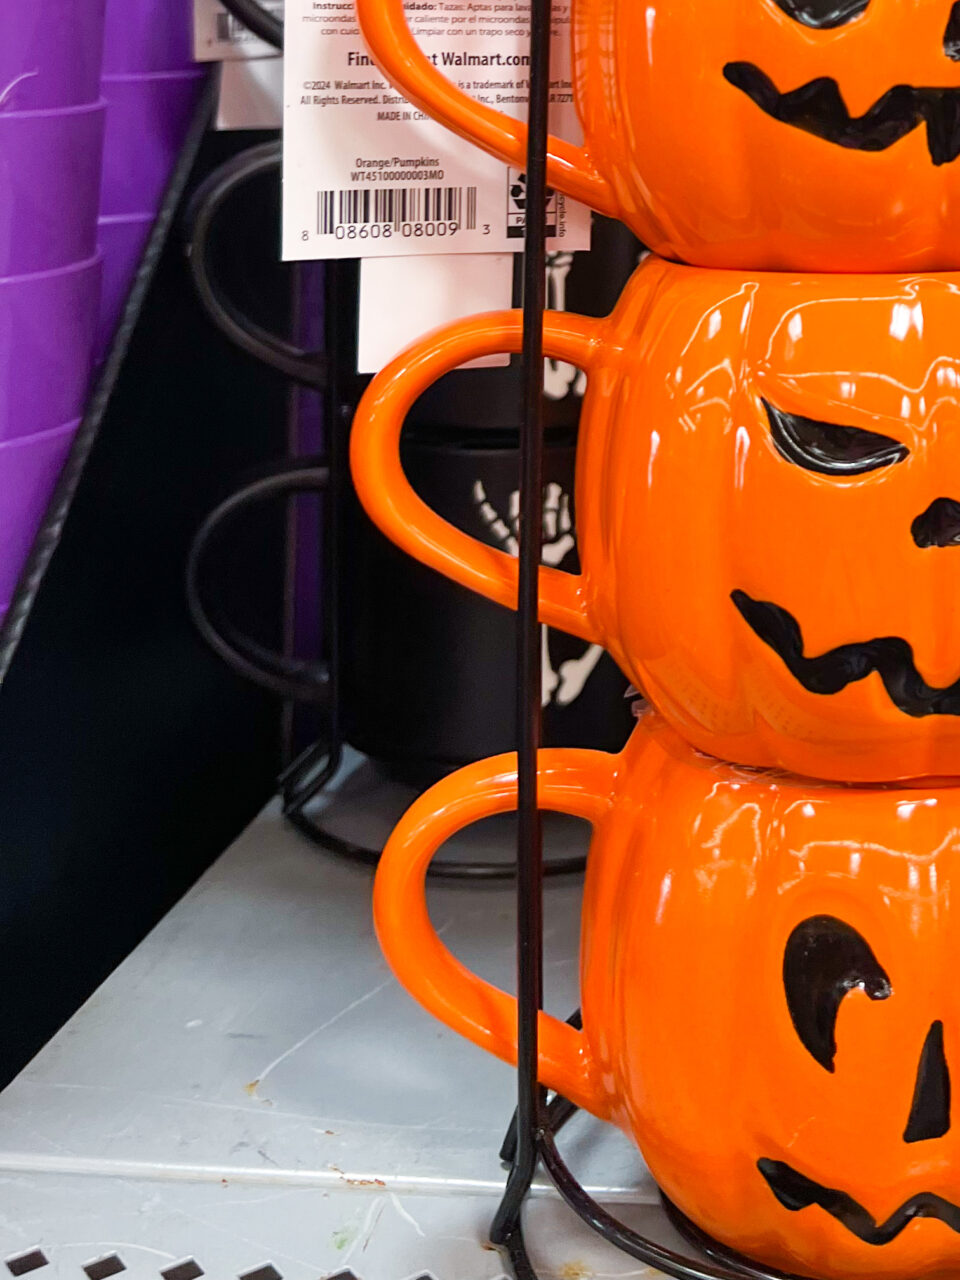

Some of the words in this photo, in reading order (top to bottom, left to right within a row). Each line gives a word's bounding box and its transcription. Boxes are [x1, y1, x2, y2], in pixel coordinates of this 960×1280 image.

[438, 2, 466, 11] Tazas:
[467, 3, 492, 12] Aptas
[415, 15, 450, 24] caliente
[468, 15, 476, 23] el
[320, 28, 338, 36] con
[479, 28, 503, 38] trapo
[505, 29, 525, 37] seco
[441, 51, 531, 67] Walmart.com
[303, 80, 330, 90] ©2024
[334, 80, 370, 90] Walmart
[371, 80, 386, 89] Inc.
[458, 81, 465, 89] is
[472, 80, 513, 89] trademark
[515, 79, 525, 89] of
[300, 95, 311, 104] All
[312, 95, 339, 107] Rights
[341, 95, 381, 105] Reserved.
[377, 111, 401, 121] MADE
[402, 111, 412, 121] IN
[355, 156, 440, 170] Orange/Pumpkins
[301, 230, 309, 241] 8
[335, 224, 393, 239] 08608
[402, 221, 459, 237] 08009
[482, 223, 491, 235] 3
